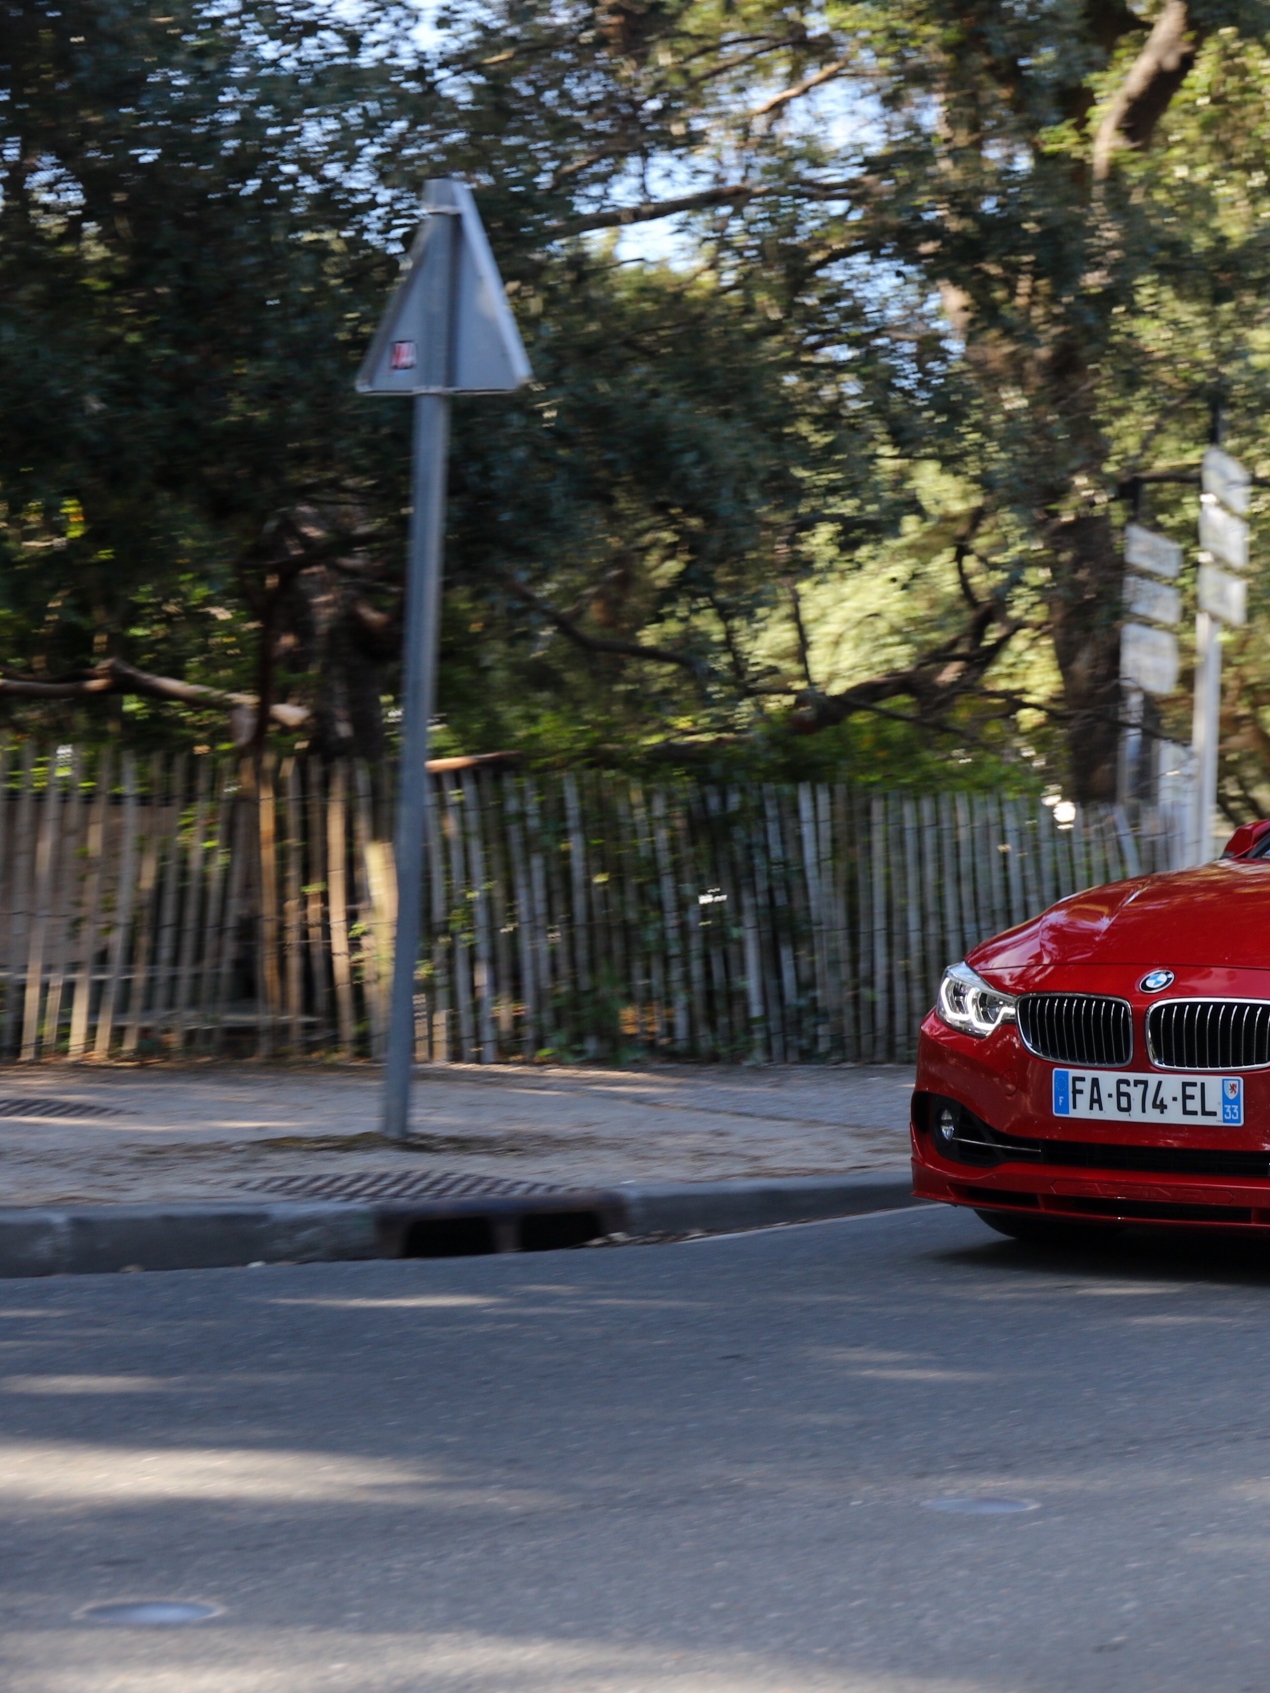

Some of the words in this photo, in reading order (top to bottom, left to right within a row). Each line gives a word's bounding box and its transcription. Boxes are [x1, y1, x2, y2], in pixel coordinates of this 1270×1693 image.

[1058, 1095, 1065, 1106] F
[1071, 1076, 1217, 1116] FA-674-EL
[1224, 1104, 1240, 1120] 33
